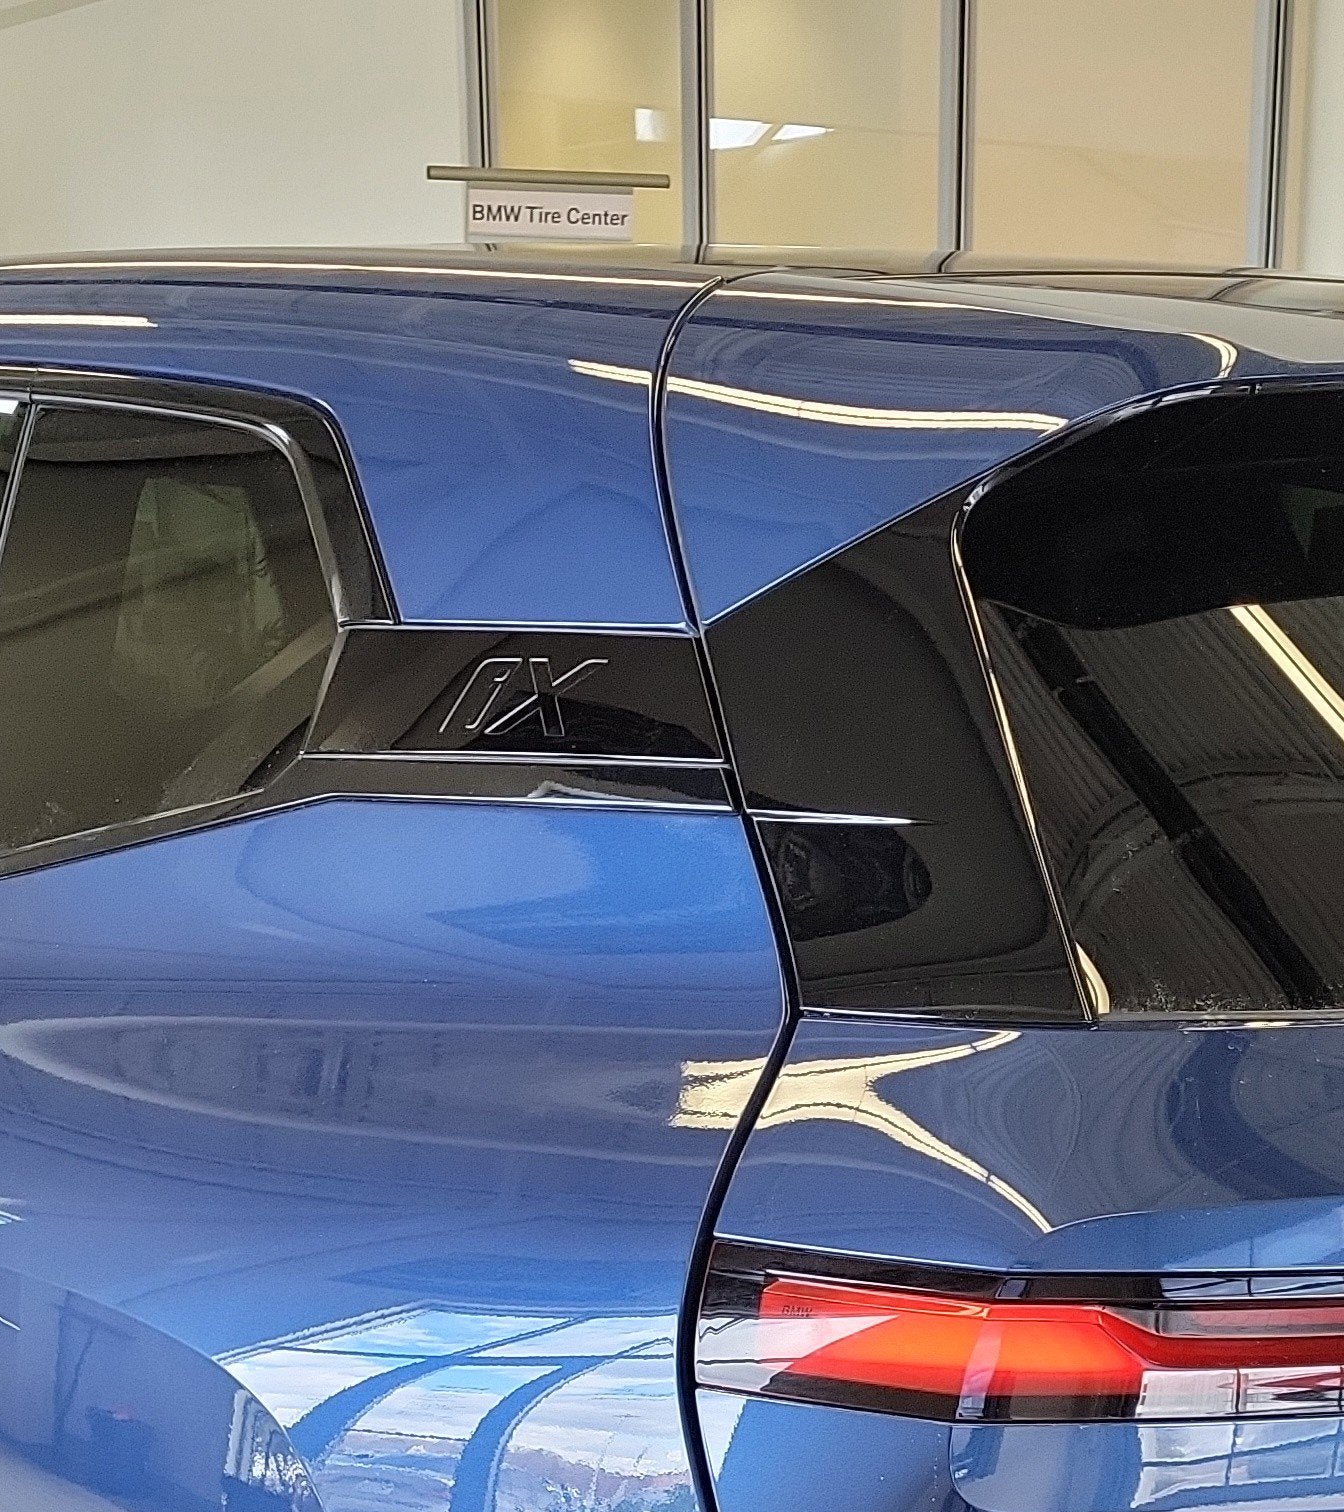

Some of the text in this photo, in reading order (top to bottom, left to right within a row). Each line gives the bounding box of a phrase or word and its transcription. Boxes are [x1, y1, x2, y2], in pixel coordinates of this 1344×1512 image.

[472, 204, 630, 227] BMW Tire Center
[439, 657, 609, 738] iX
